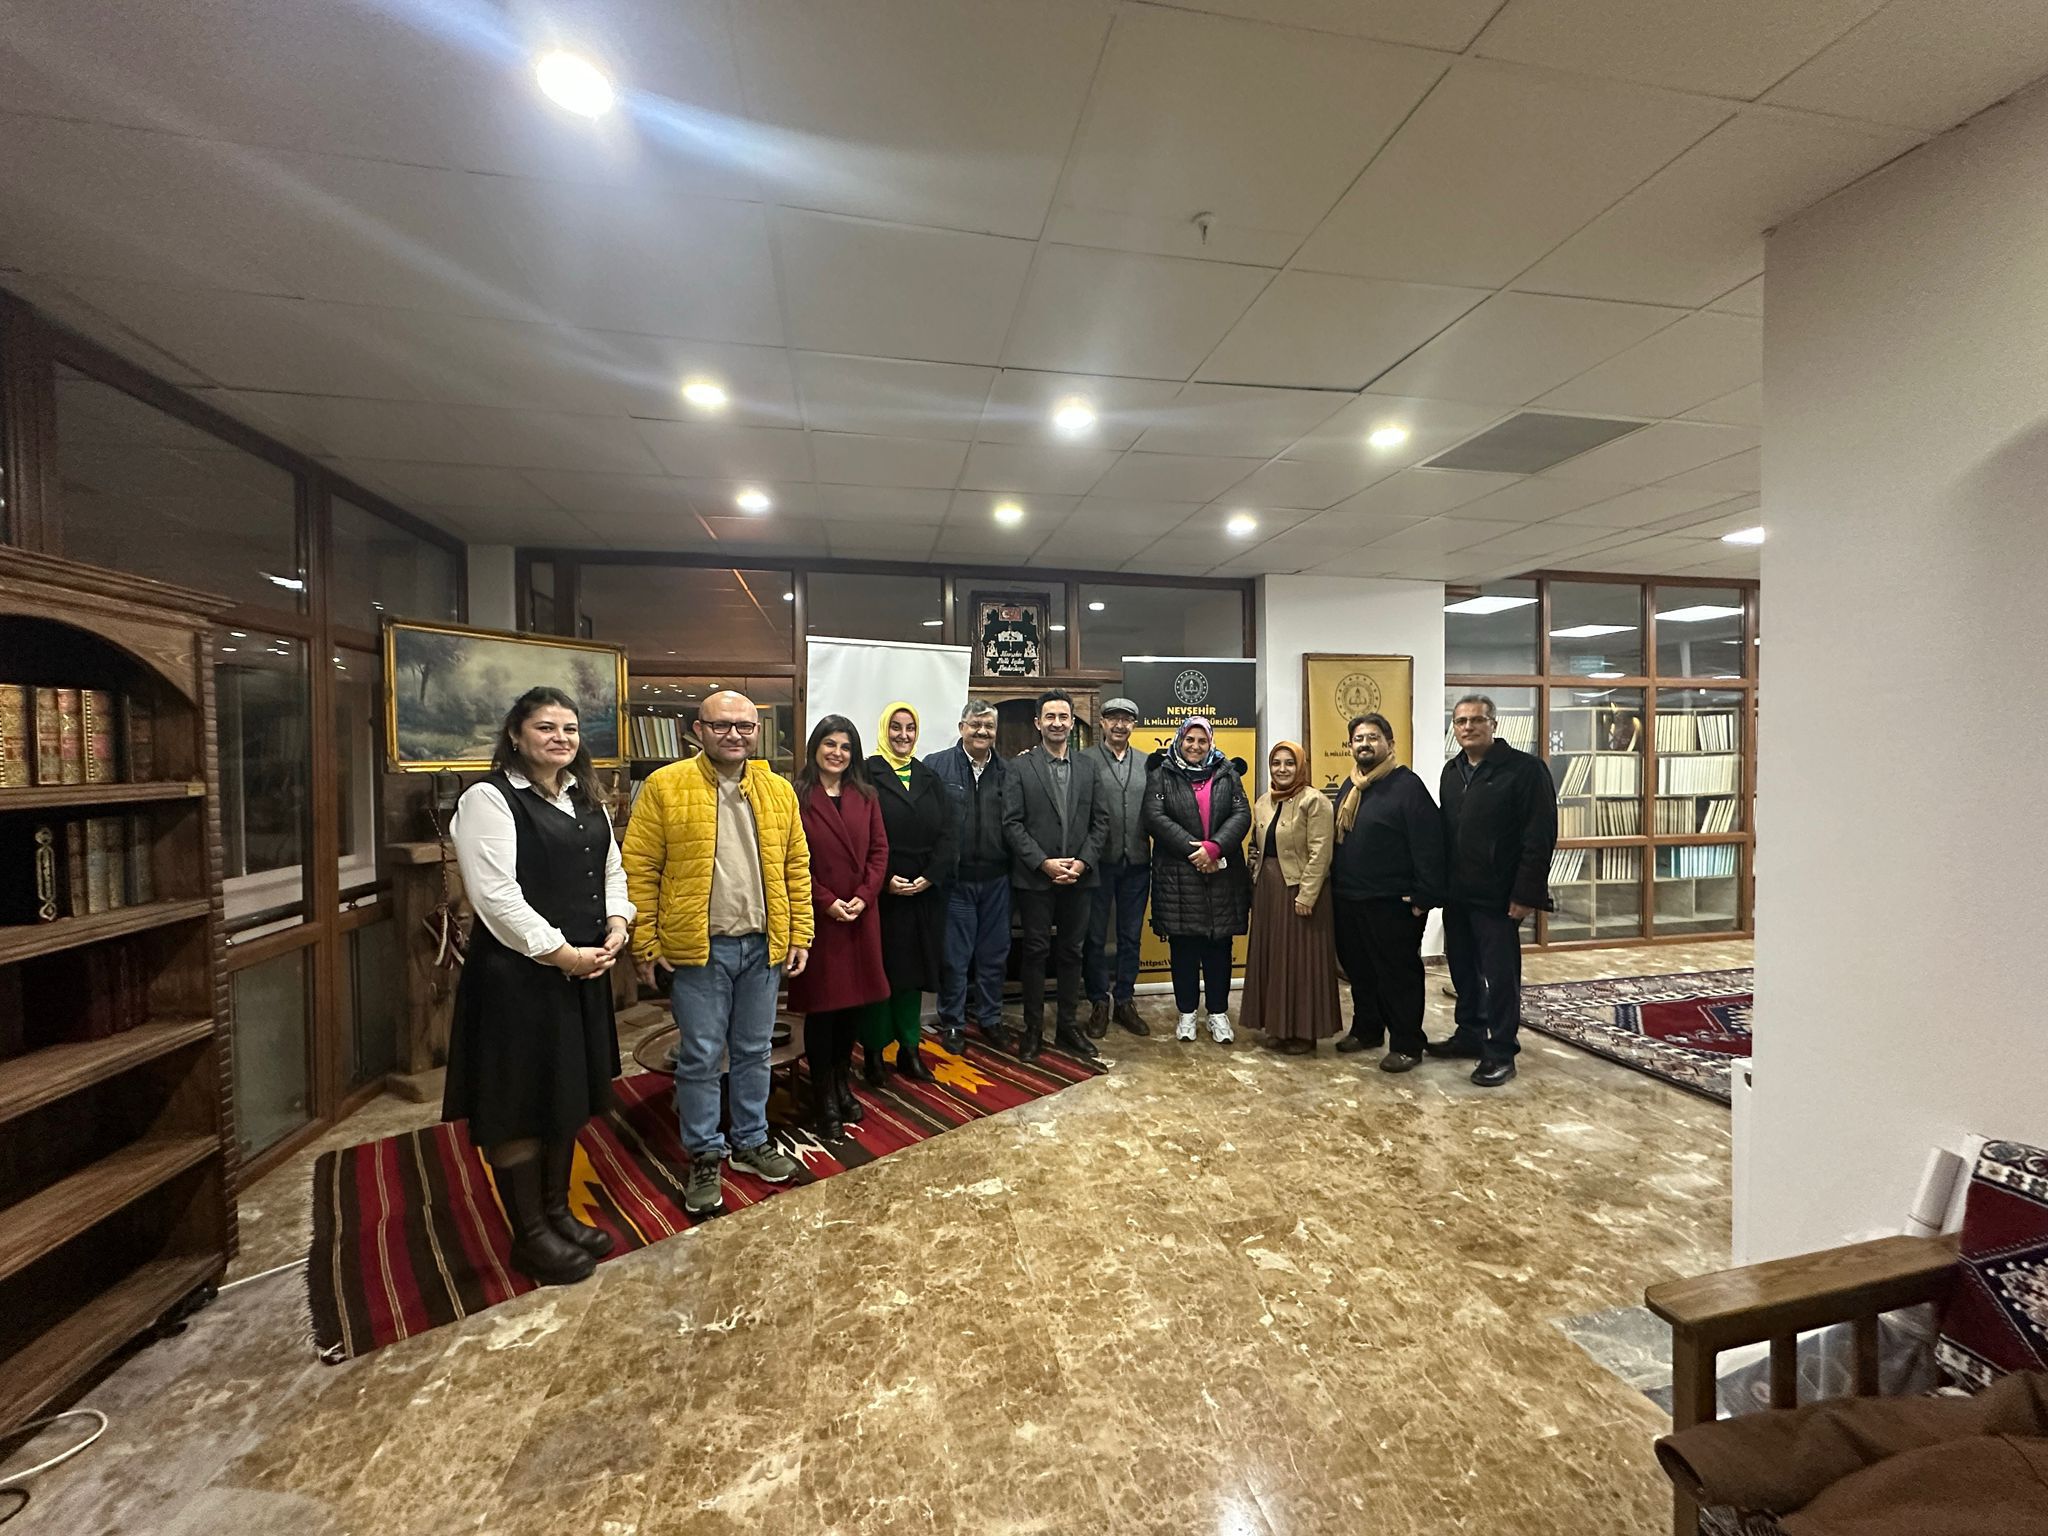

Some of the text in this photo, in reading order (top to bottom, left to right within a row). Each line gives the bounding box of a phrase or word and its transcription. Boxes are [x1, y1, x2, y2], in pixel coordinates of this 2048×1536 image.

[1167, 704, 1216, 717] NEVŞEHİR
[1144, 717, 1150, 726] İL
[1151, 717, 1169, 726] MİLLİ
